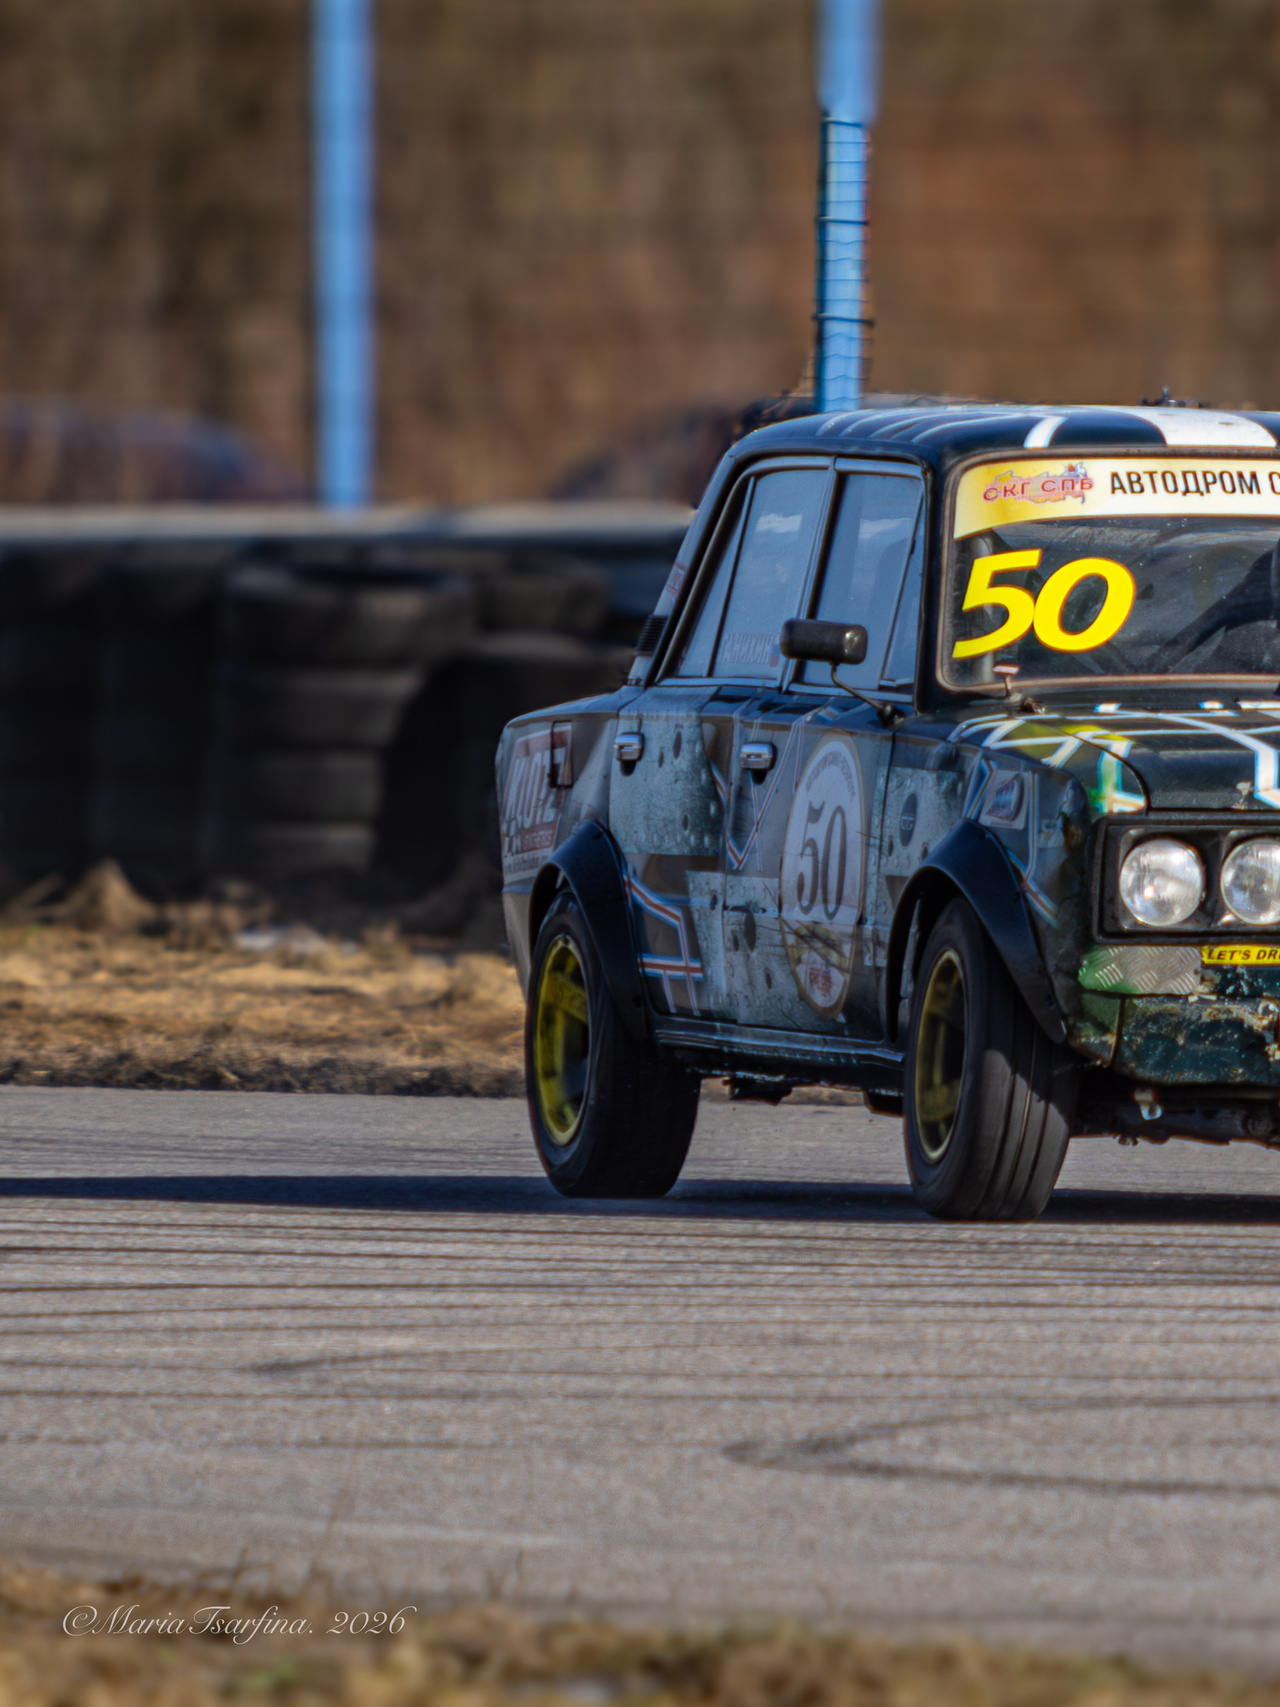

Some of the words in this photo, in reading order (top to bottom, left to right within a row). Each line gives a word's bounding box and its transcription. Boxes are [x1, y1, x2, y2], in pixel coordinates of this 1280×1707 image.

[983, 482, 1031, 501] СКГ
[1041, 478, 1094, 494] СПБ
[1110, 470, 1261, 497] АВТОДРОМ
[953, 549, 1135, 658] 50
[797, 800, 847, 920] 50
[1207, 949, 1251, 961] LET'S
